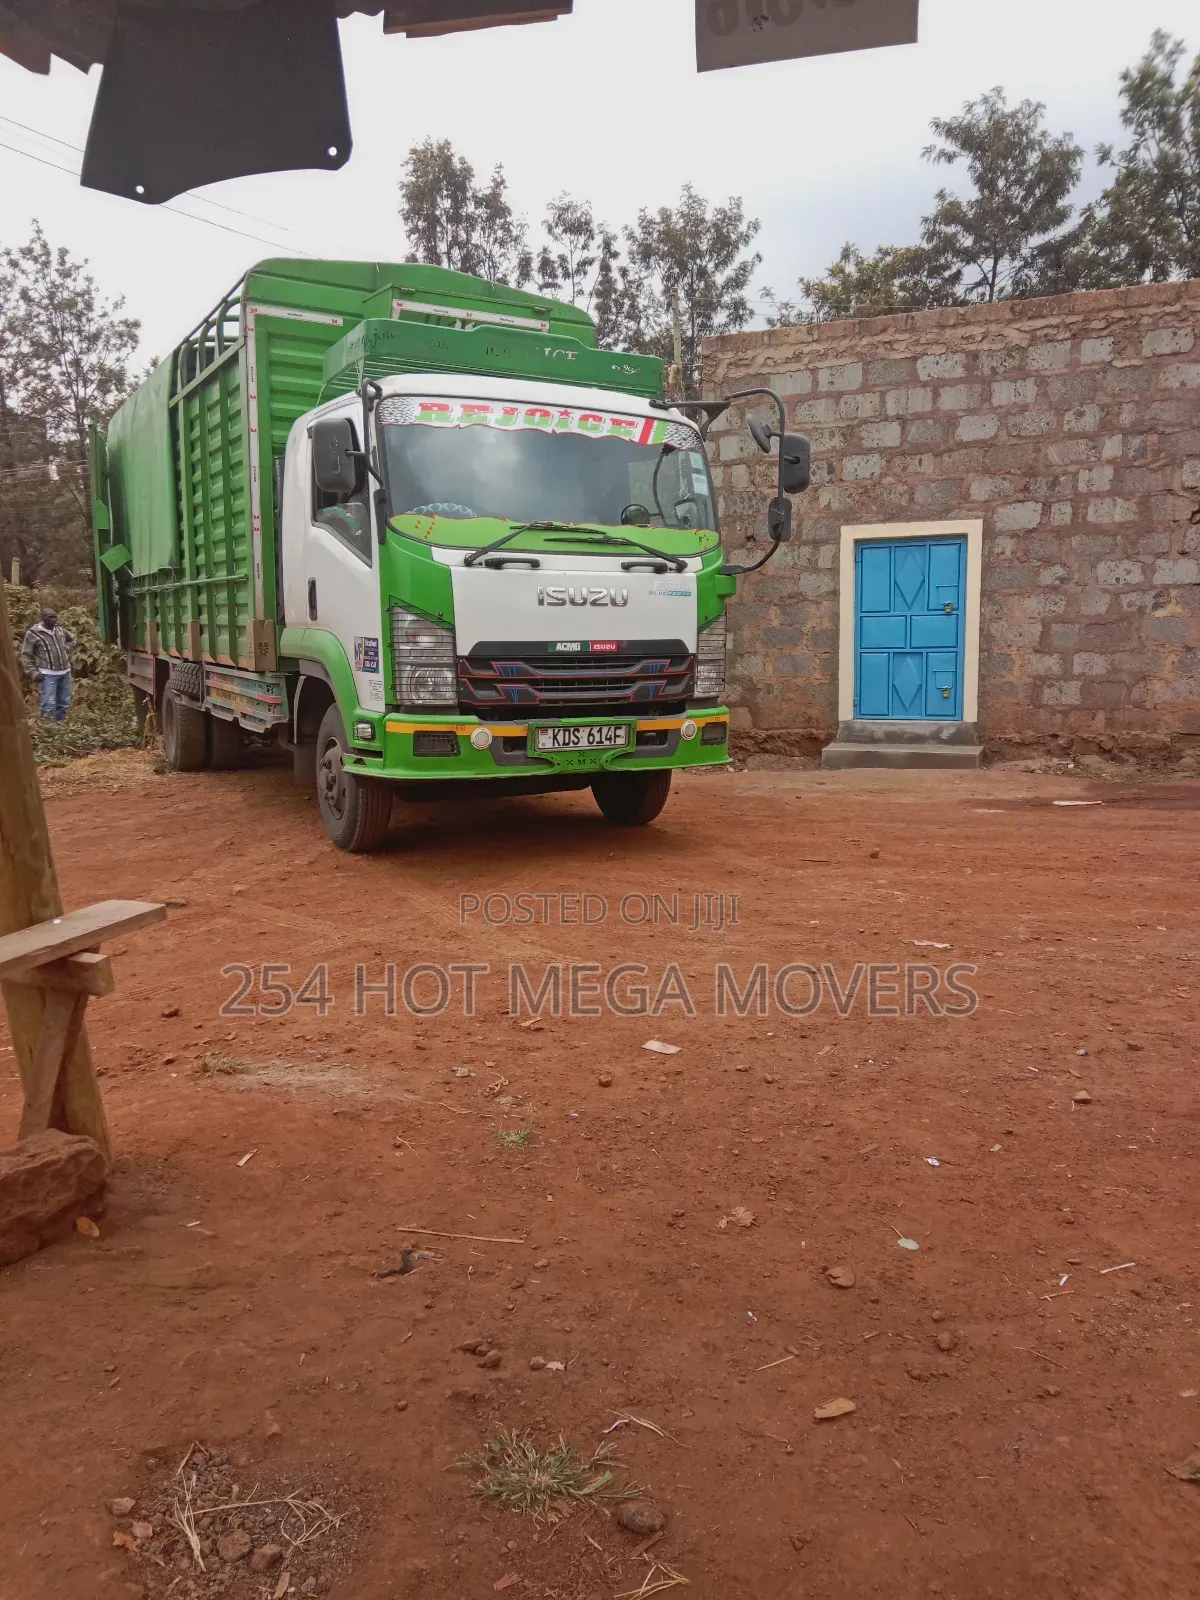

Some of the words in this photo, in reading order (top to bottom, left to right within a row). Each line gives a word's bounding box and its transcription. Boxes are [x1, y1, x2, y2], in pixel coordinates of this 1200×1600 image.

[414, 402, 639, 438] REJOICE
[537, 586, 629, 607] ISUZU
[556, 642, 581, 651] ACMG
[552, 728, 581, 747] KDS
[587, 726, 623, 745] 614F
